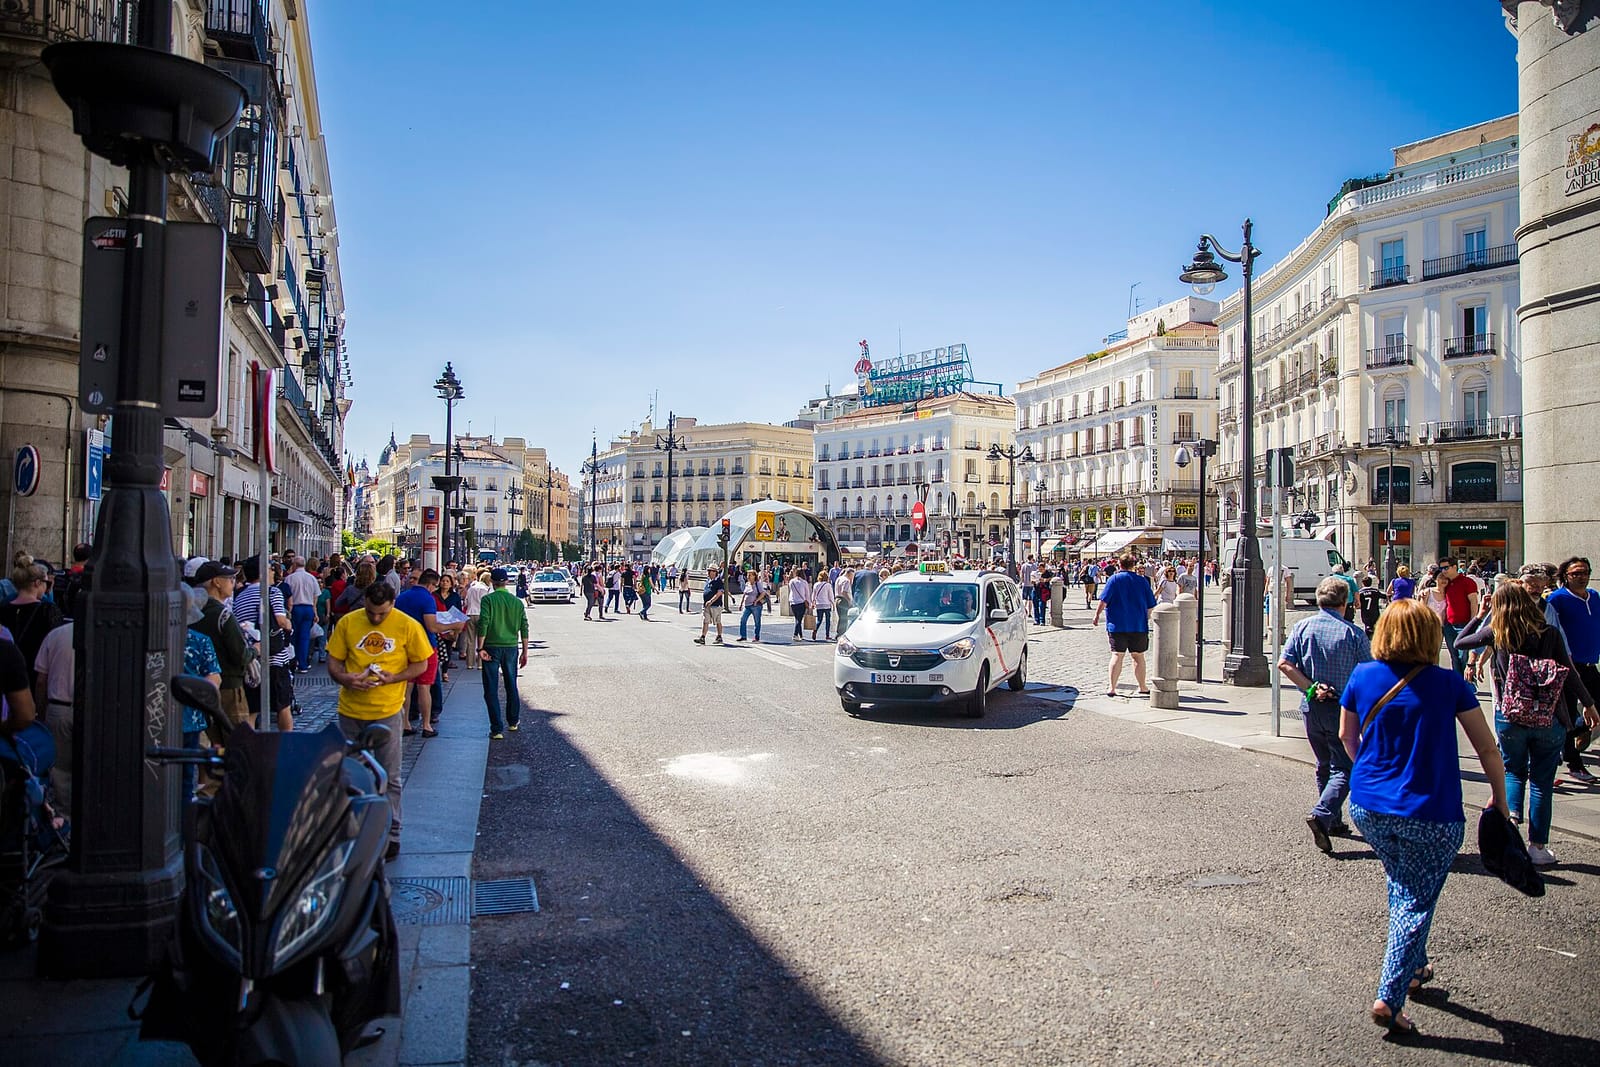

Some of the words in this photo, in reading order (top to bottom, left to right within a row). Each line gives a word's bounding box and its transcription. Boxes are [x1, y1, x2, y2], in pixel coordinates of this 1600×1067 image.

[1175, 507, 1196, 515] ORO
[1364, 597, 1372, 610] 7
[876, 674, 898, 683] 3192
[899, 675, 916, 683] JCT
